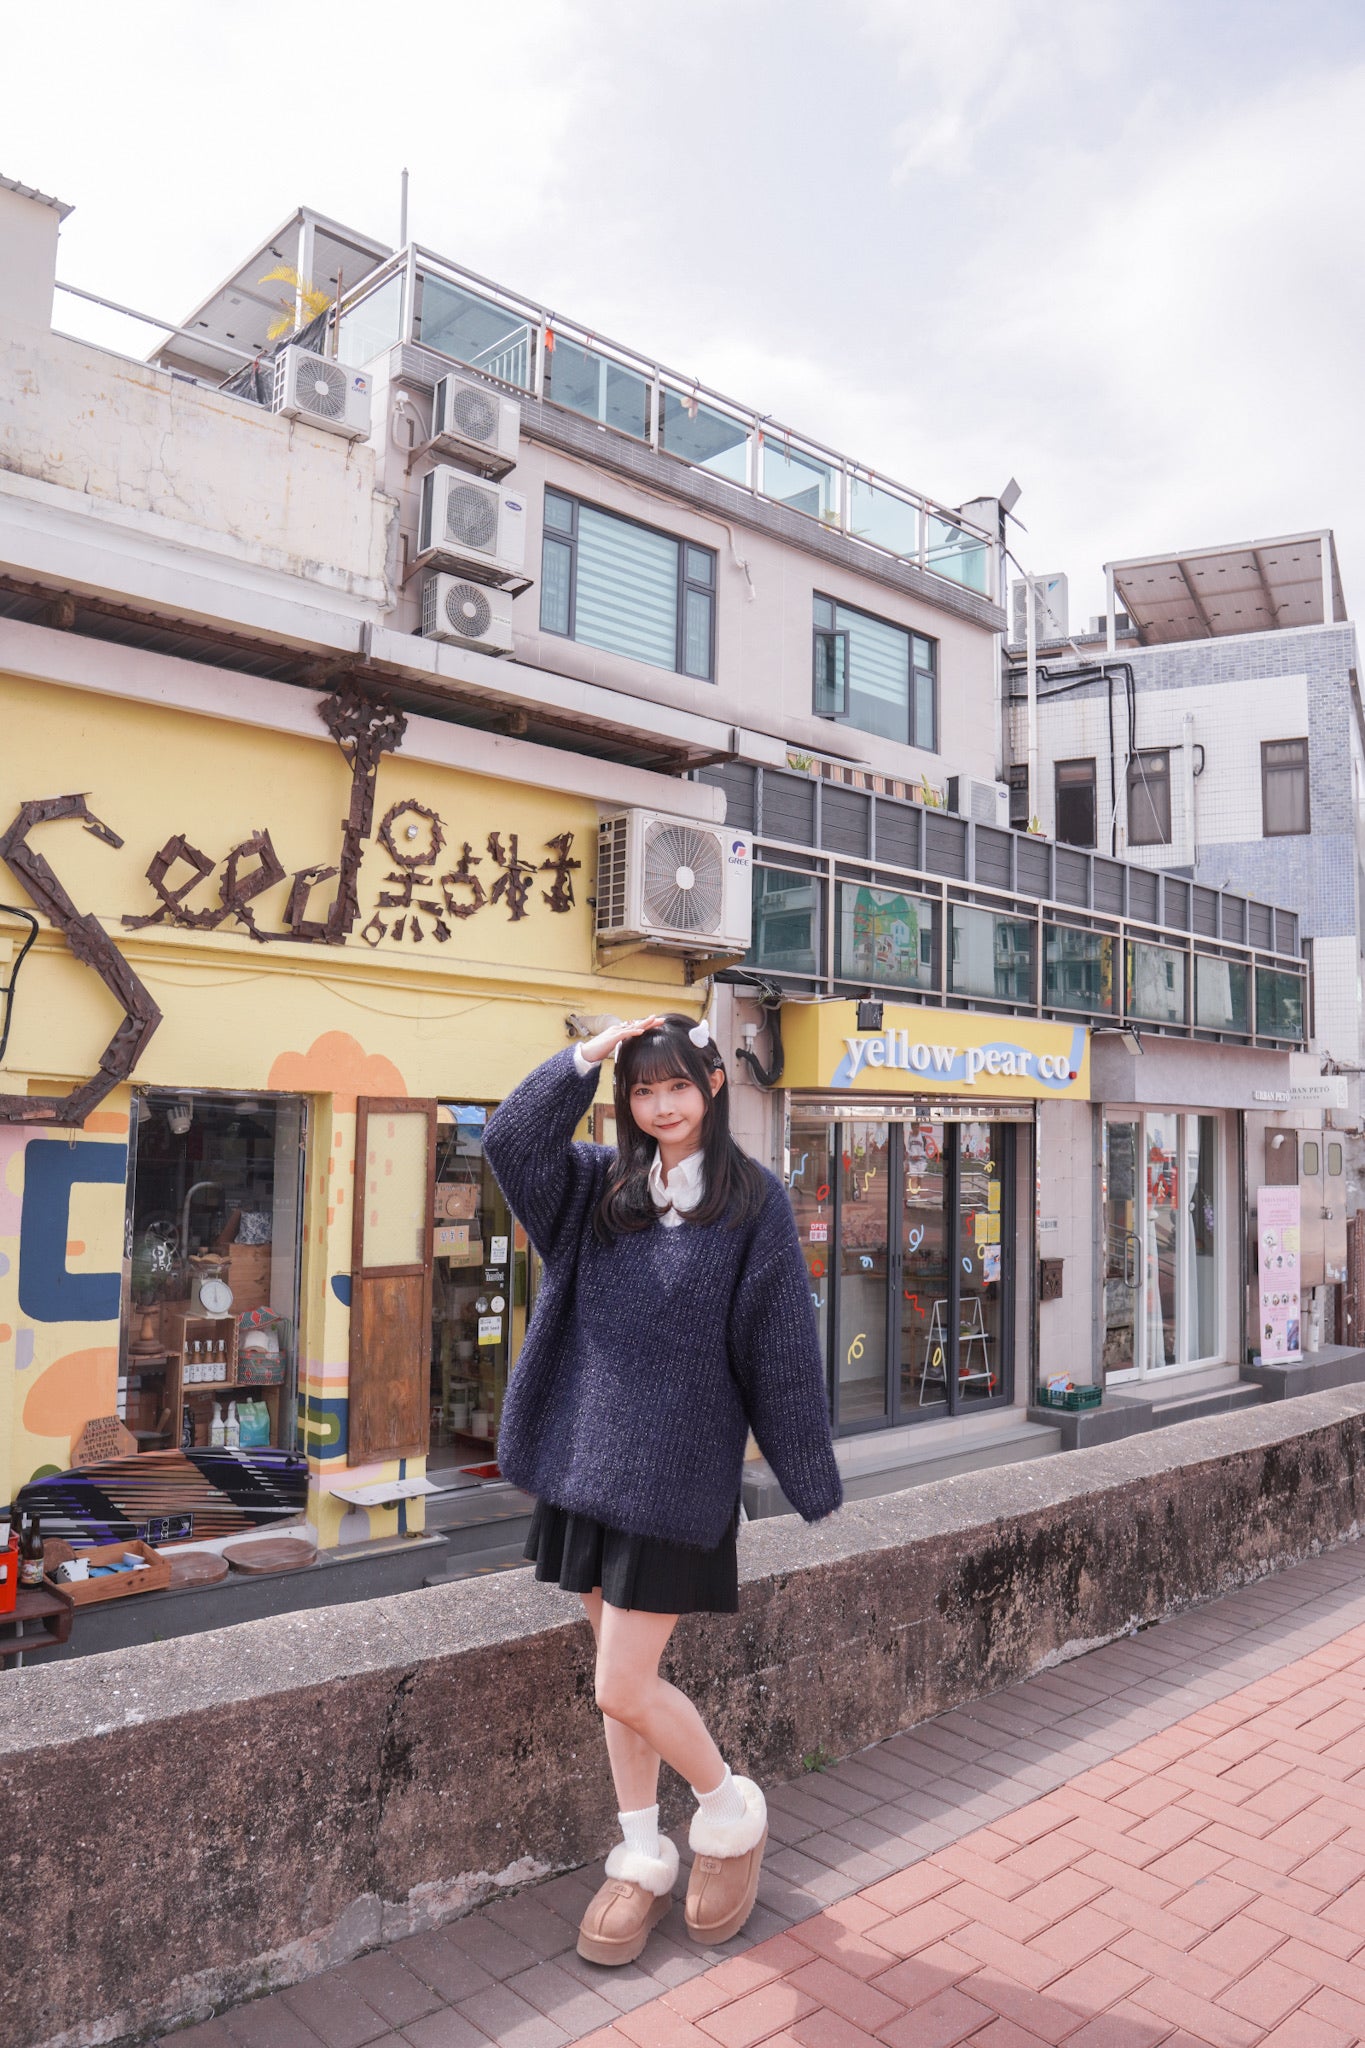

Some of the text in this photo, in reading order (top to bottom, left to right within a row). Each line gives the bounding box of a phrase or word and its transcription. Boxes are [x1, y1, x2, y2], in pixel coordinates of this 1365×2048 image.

[728, 856, 750, 867] GREE
[0, 678, 408, 1130] Seed
[843, 1028, 1077, 1085] yellow pear co.
